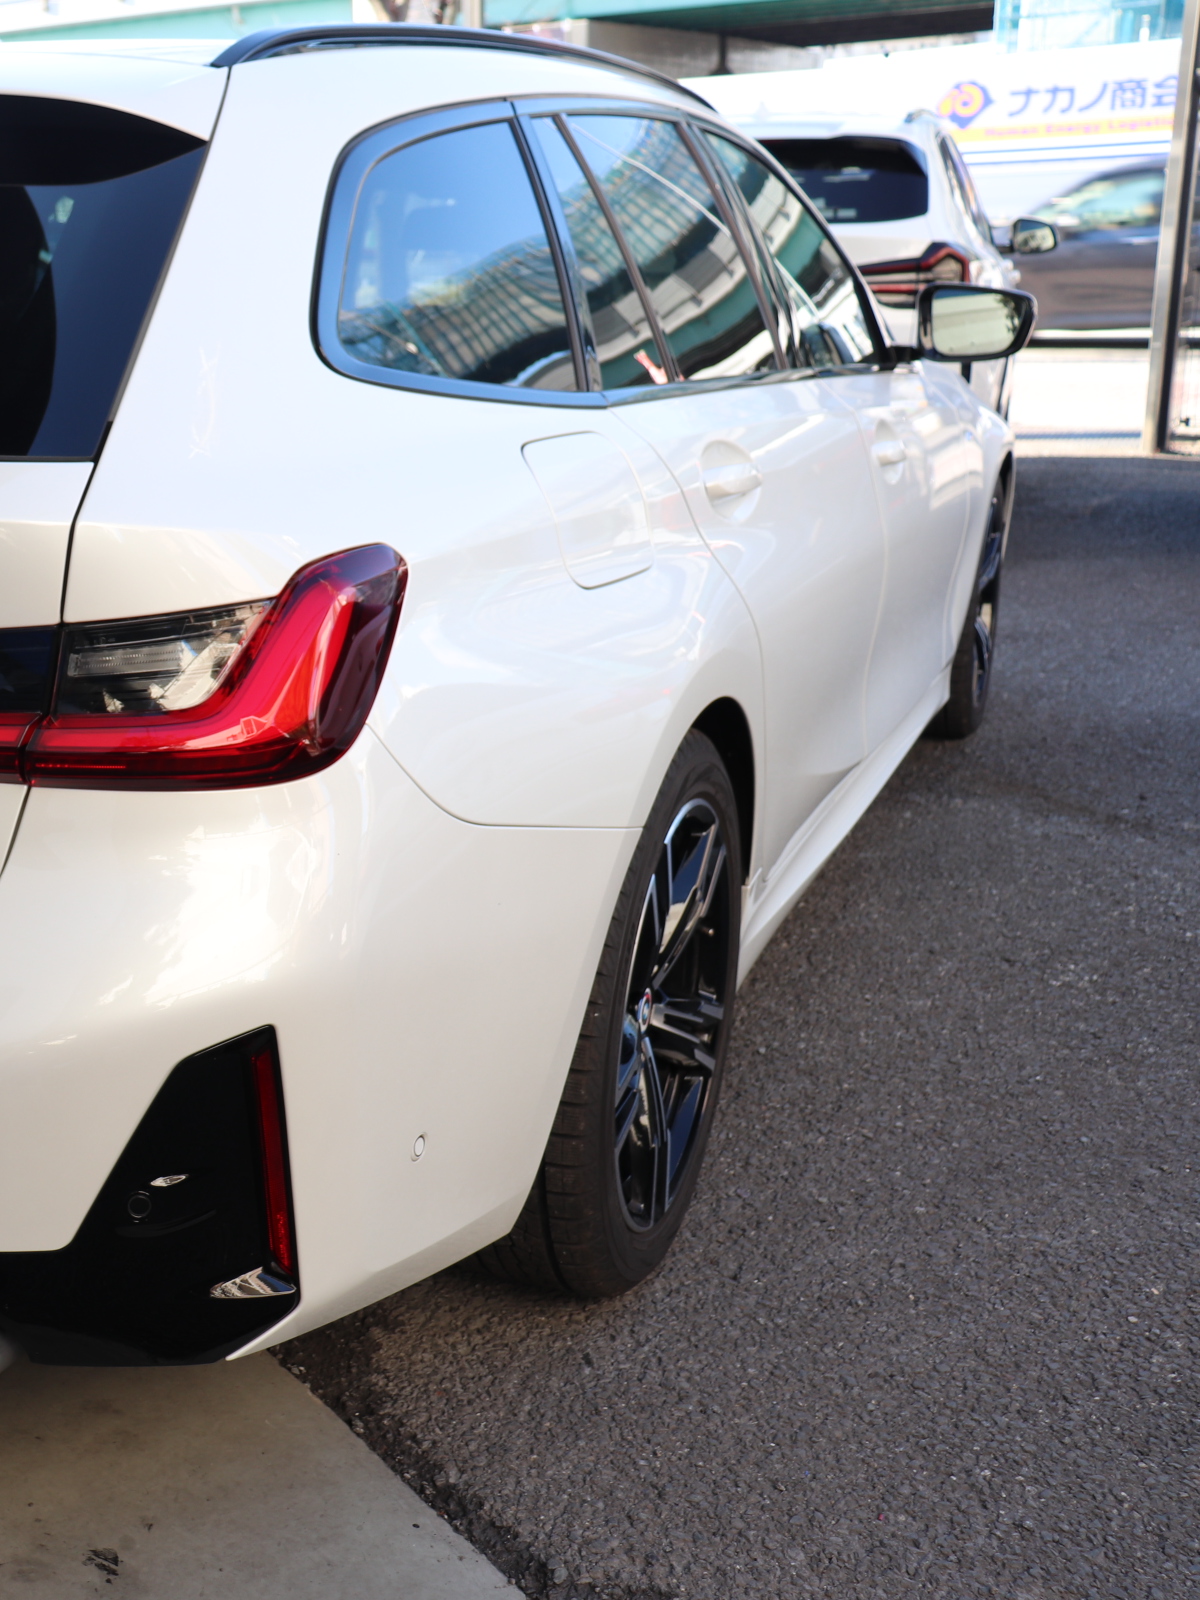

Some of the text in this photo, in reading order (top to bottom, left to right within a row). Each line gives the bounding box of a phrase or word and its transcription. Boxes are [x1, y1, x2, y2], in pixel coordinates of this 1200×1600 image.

[1008, 76, 1178, 117] ナカノ商会
